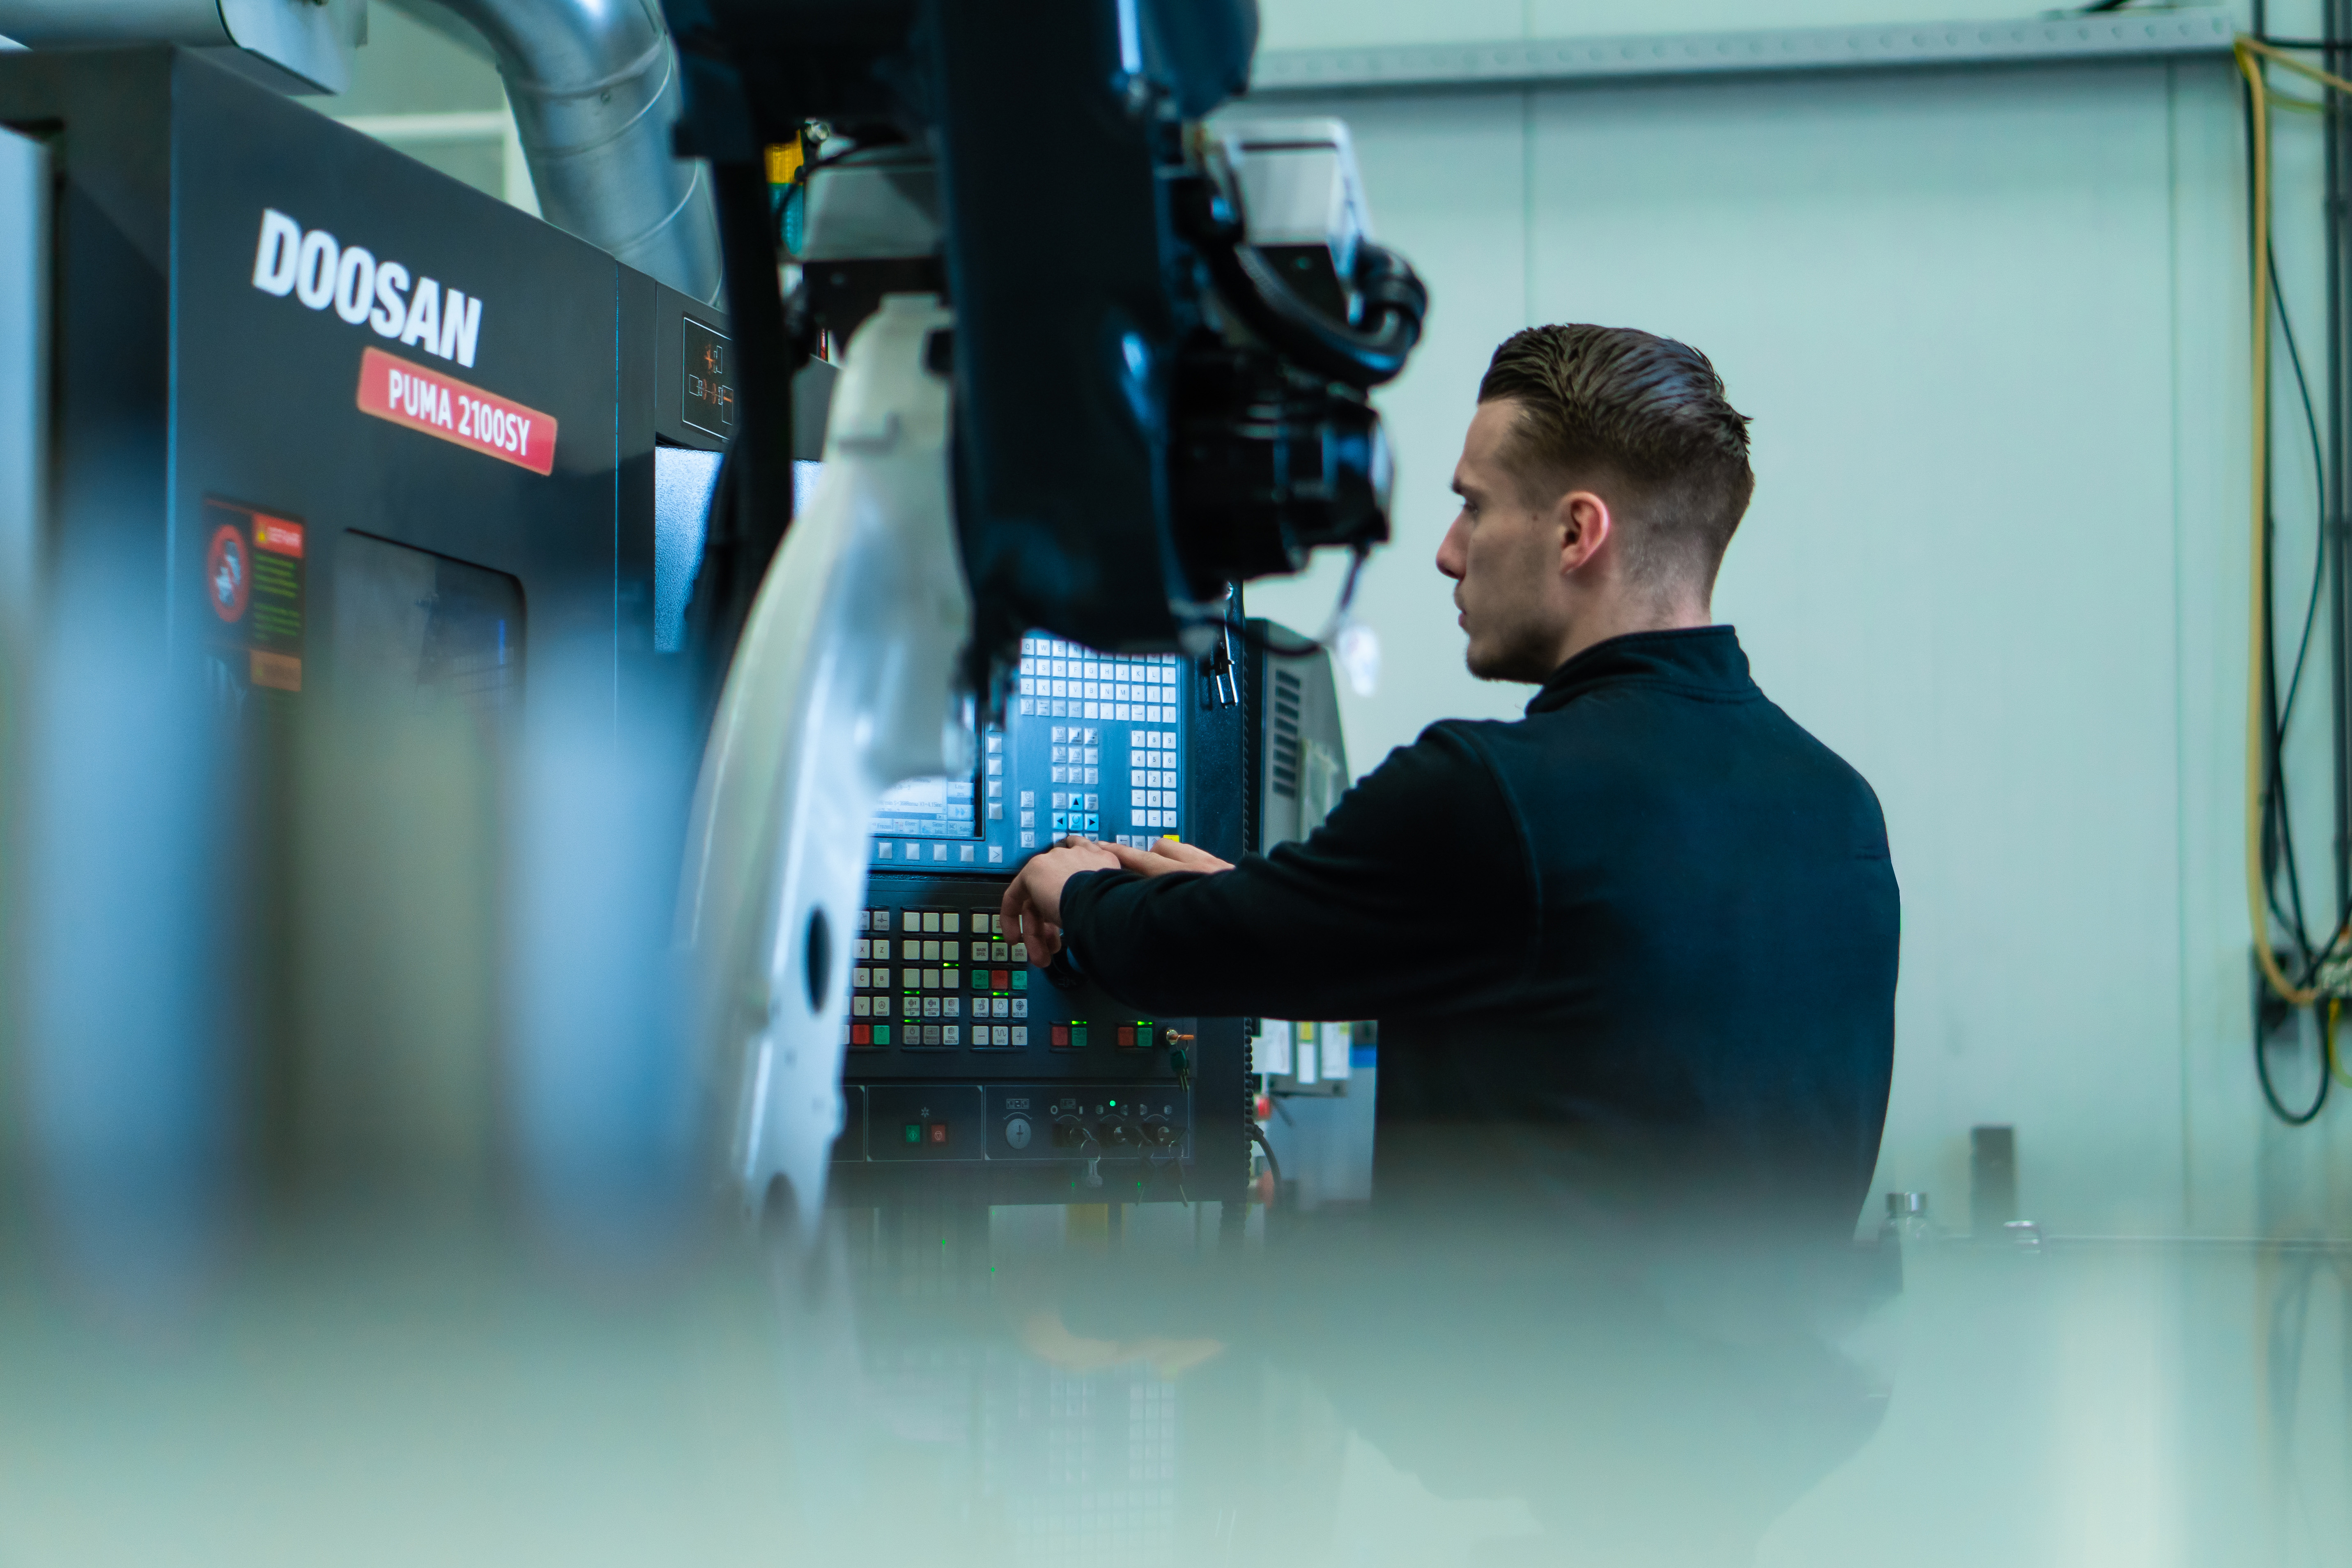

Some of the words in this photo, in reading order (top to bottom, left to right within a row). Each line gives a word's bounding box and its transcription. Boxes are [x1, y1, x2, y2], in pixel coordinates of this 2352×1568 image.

[251, 207, 483, 368] DOOSAN
[389, 369, 453, 430] PUMA
[458, 395, 531, 456] 2100SY
